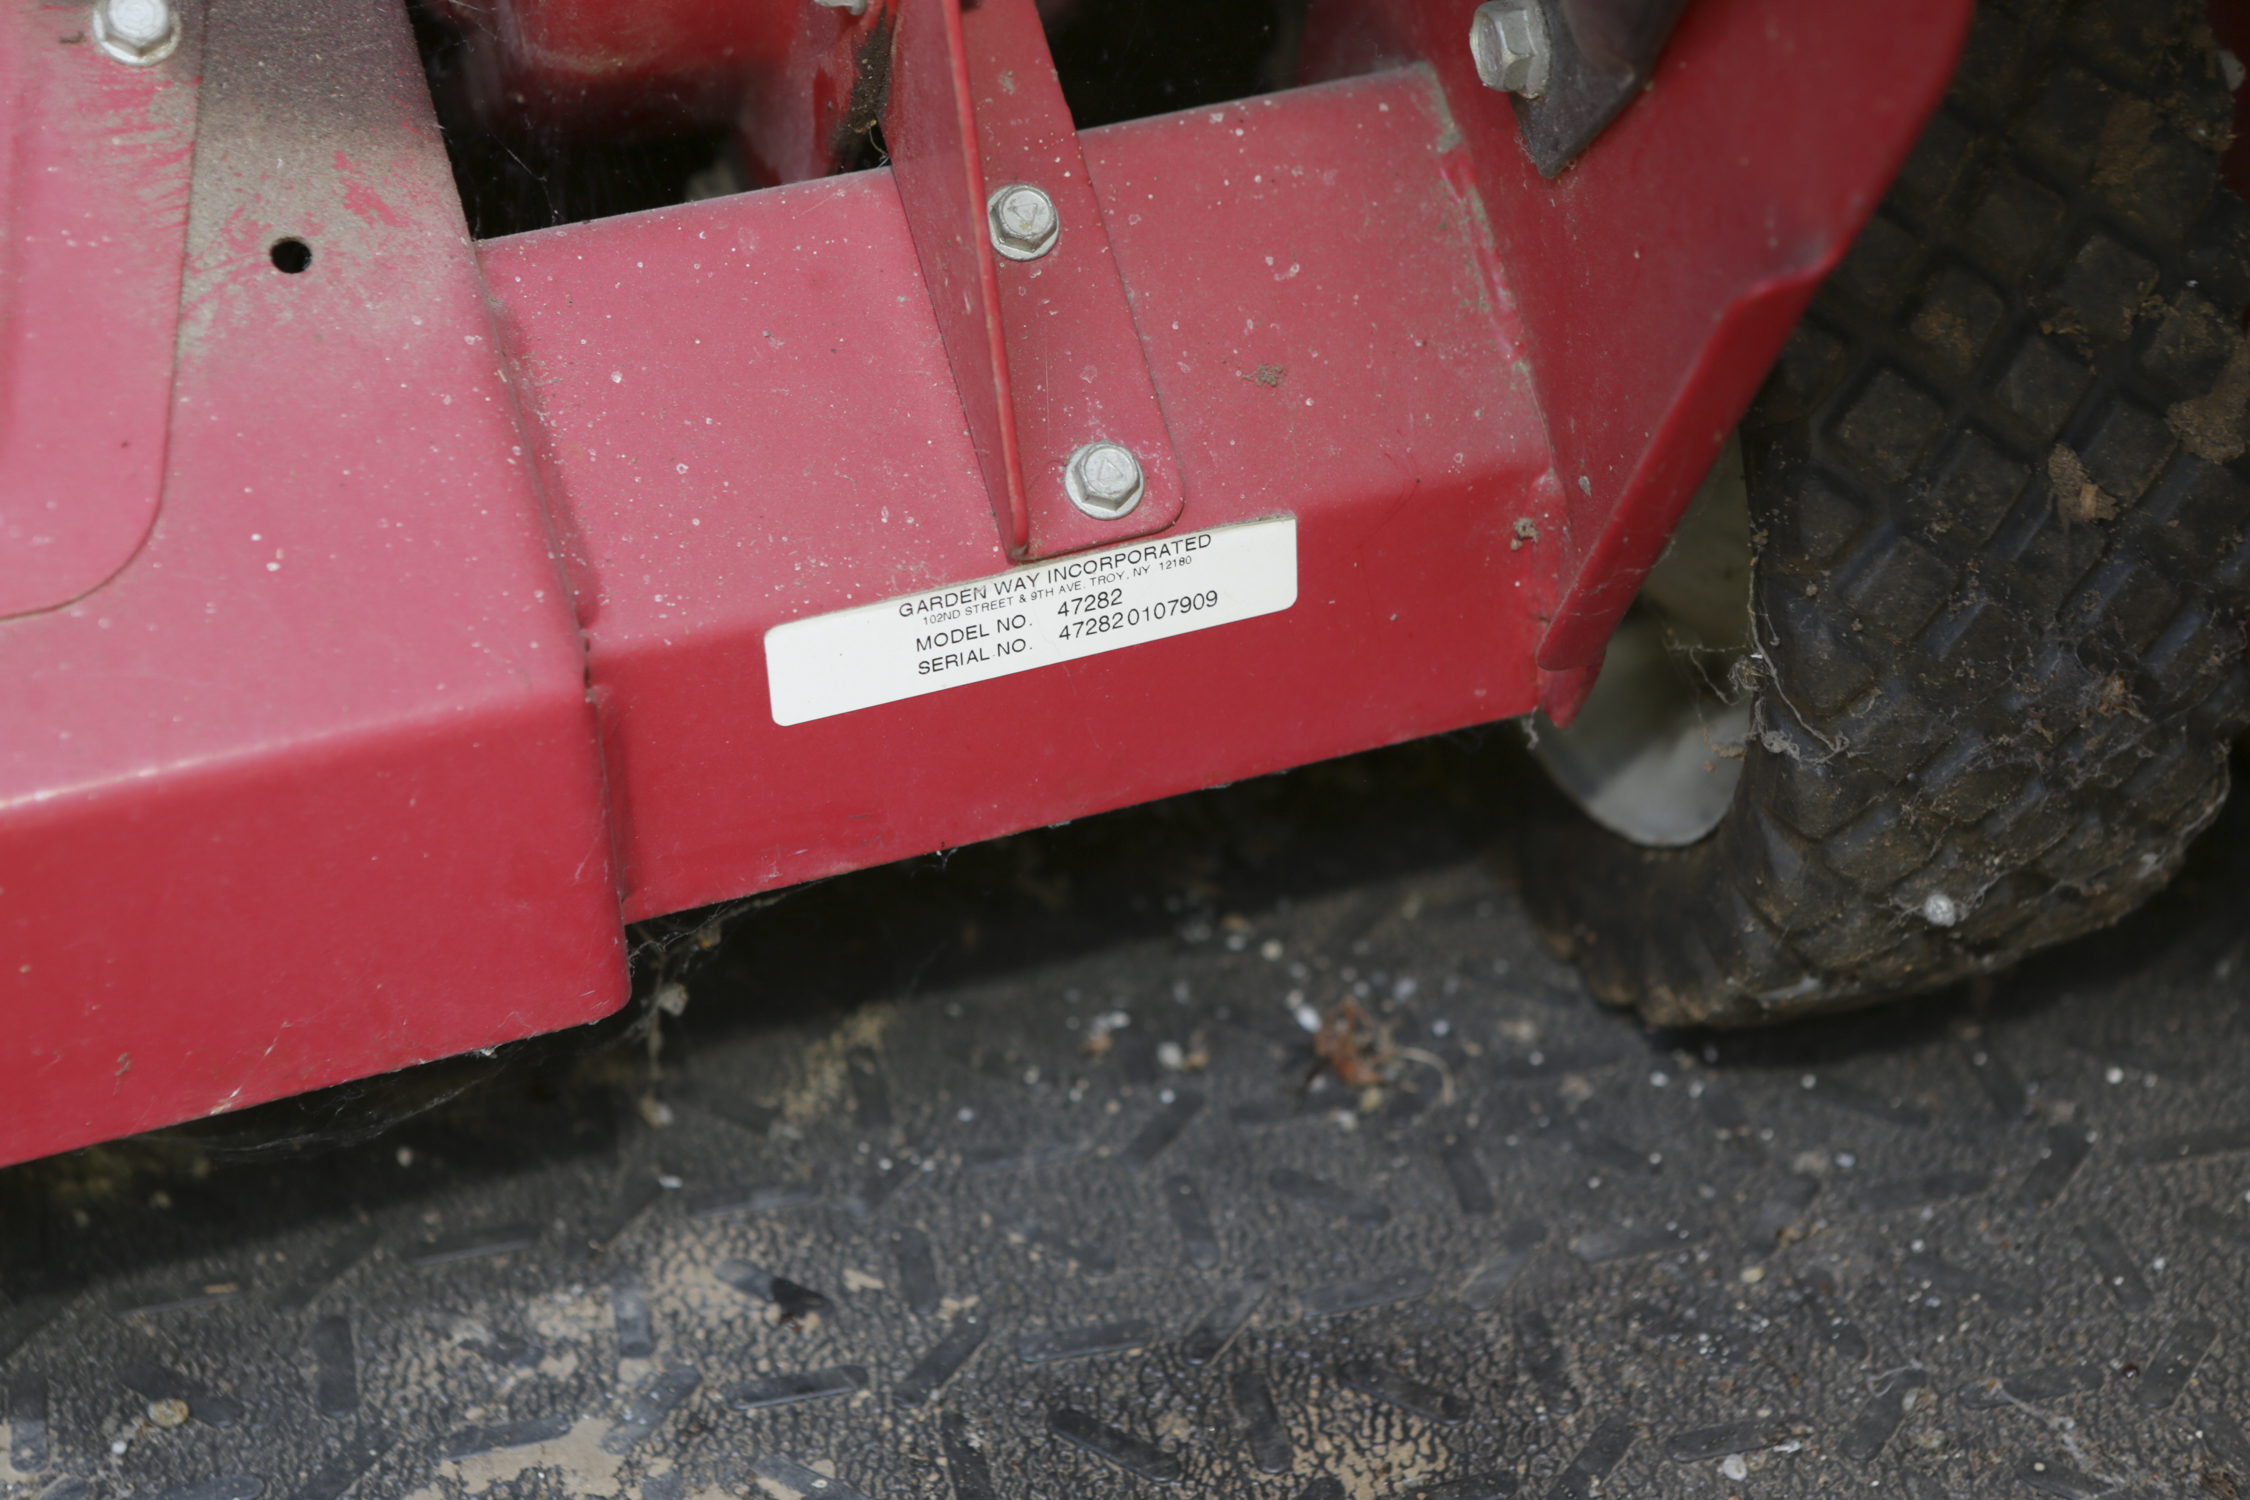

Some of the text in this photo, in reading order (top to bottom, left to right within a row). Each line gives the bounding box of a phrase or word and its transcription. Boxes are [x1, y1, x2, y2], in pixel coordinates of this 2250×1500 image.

[899, 533, 1212, 618] GARDEN WAY INCORPORATED
[923, 608, 961, 626] 102ND
[965, 596, 1014, 617] STREET
[1018, 595, 1027, 604] &
[1030, 587, 1054, 601] 9TH
[1058, 581, 1086, 596] AVE.
[1133, 564, 1150, 578] NY
[1159, 555, 1192, 572] 12180
[916, 588, 1123, 652] MODEL NO. 47282
[918, 648, 989, 675] SERIAL
[997, 638, 1033, 658] NO.
